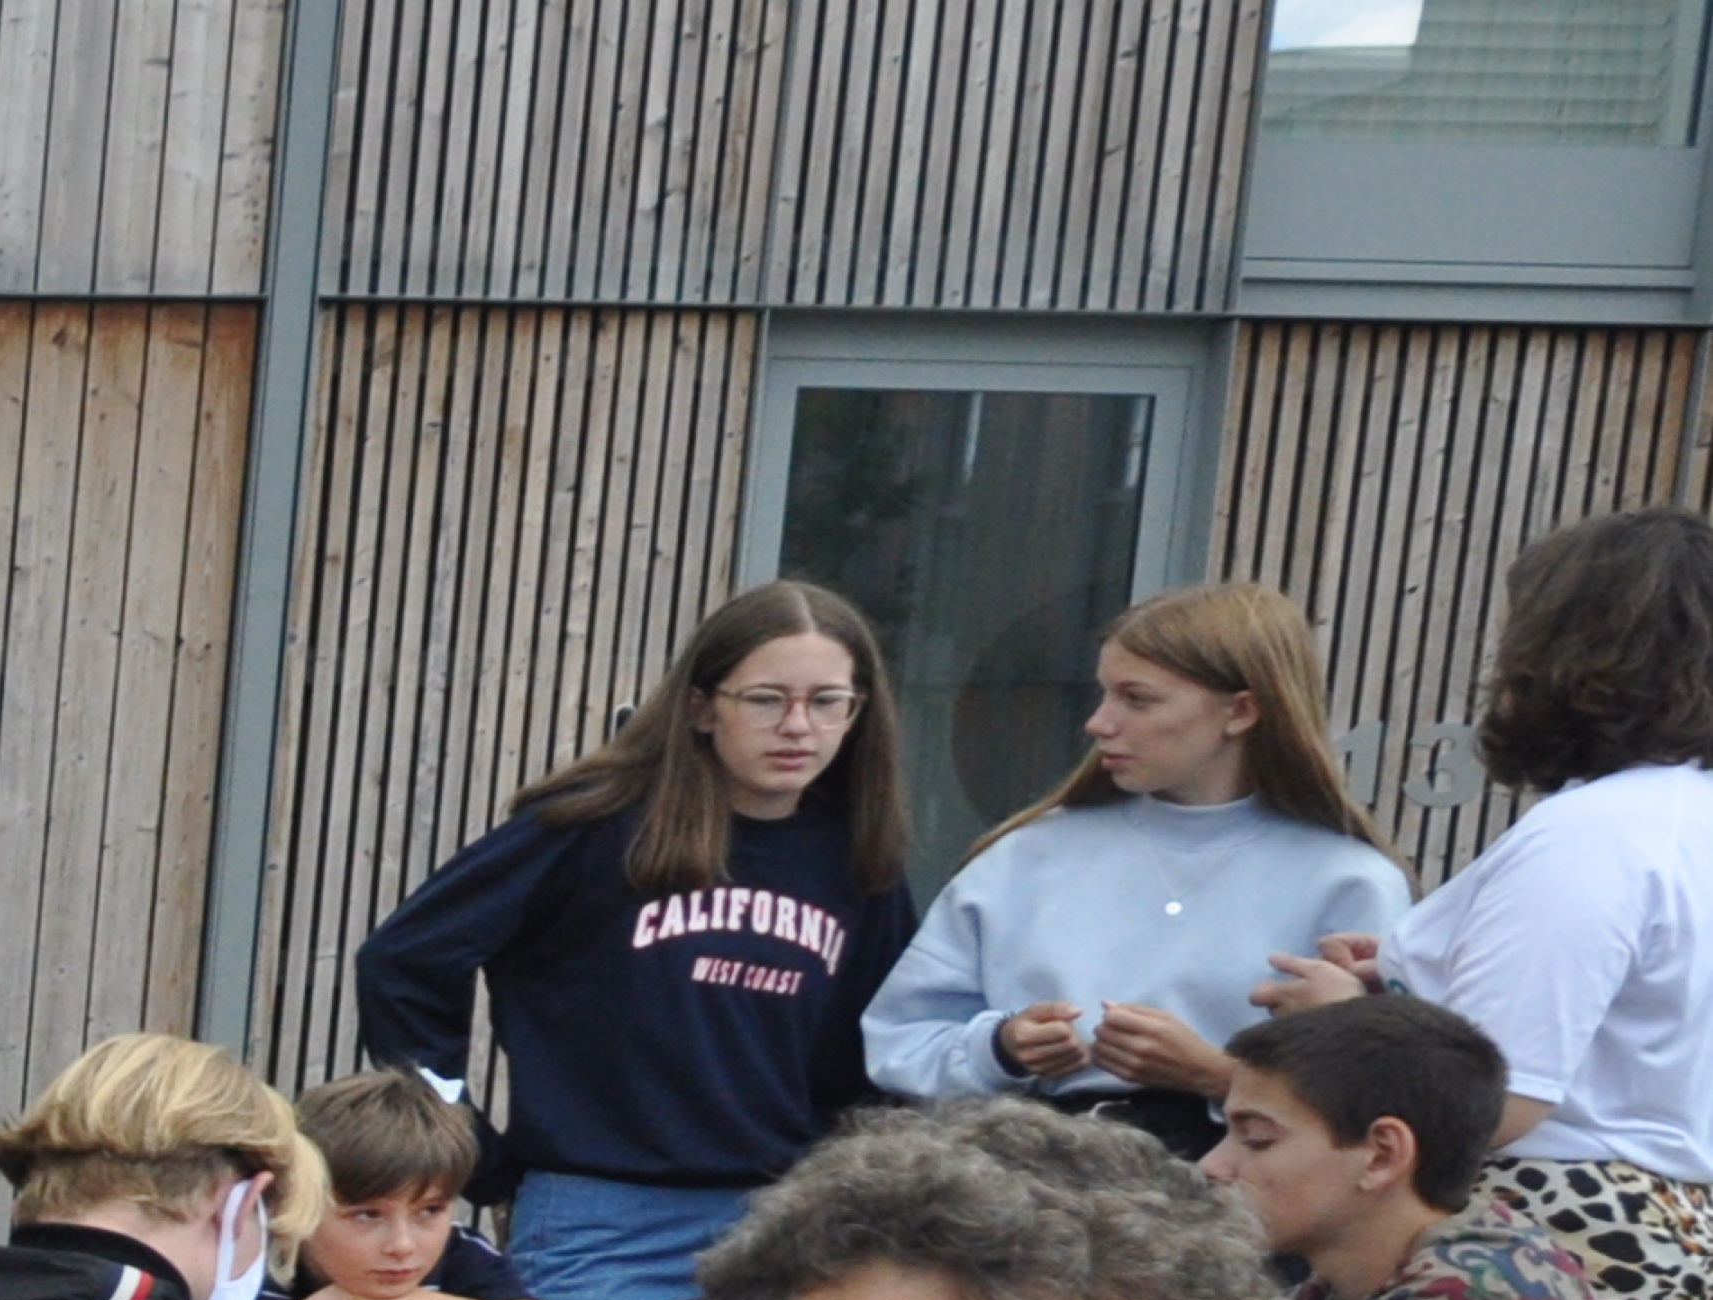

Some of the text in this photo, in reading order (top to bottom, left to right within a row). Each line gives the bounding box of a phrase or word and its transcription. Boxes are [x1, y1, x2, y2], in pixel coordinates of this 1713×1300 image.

[1329, 720, 1487, 808] 13
[631, 887, 846, 977] CALIFORNIA
[691, 956, 804, 995] WEST COAST
